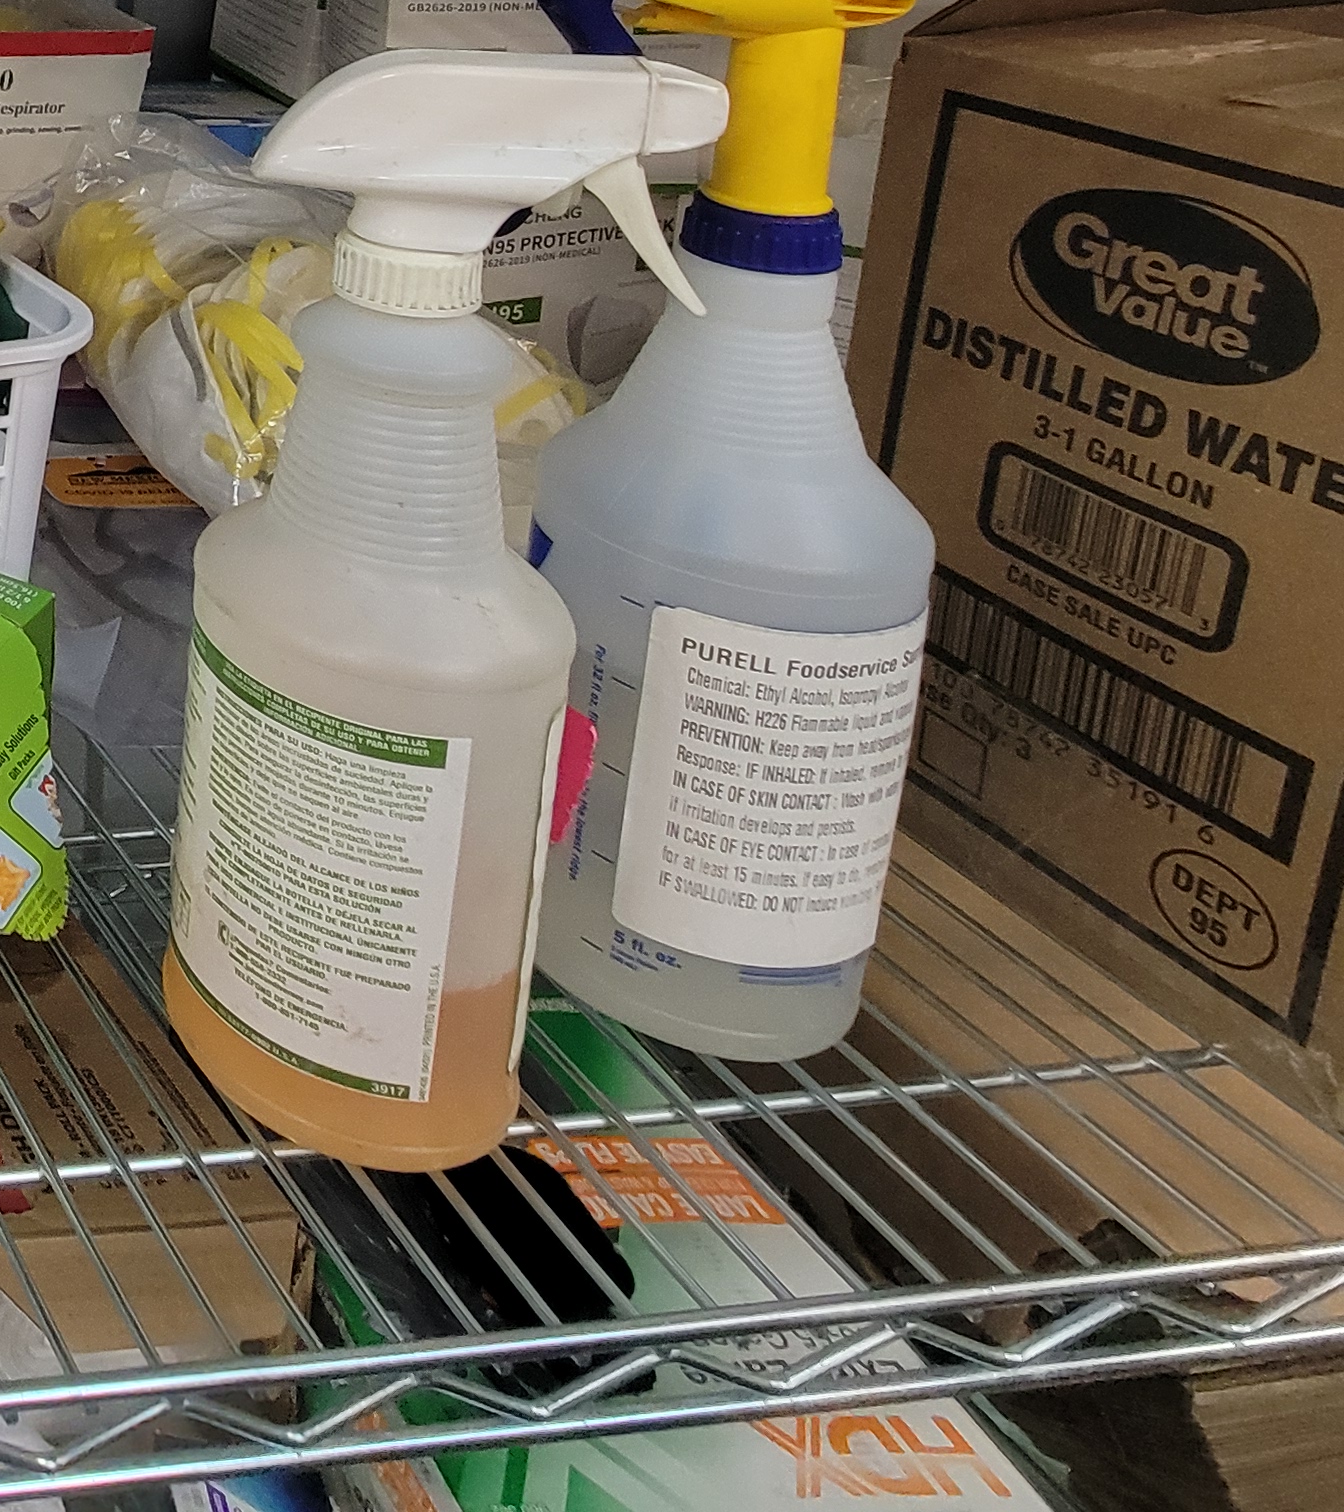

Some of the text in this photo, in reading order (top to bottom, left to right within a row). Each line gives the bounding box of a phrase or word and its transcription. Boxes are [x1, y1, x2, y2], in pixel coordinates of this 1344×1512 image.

[1053, 211, 1263, 327] Great
[1092, 278, 1249, 361] Value
[923, 306, 1167, 440] DISTILLED
[1033, 414, 1215, 510] 3-1 GALLON
[681, 637, 897, 679] PURELL Foodservice
[1006, 565, 1178, 667] CASE SALE UPC
[1171, 860, 1261, 935] DEPT
[1190, 909, 1230, 947] 95
